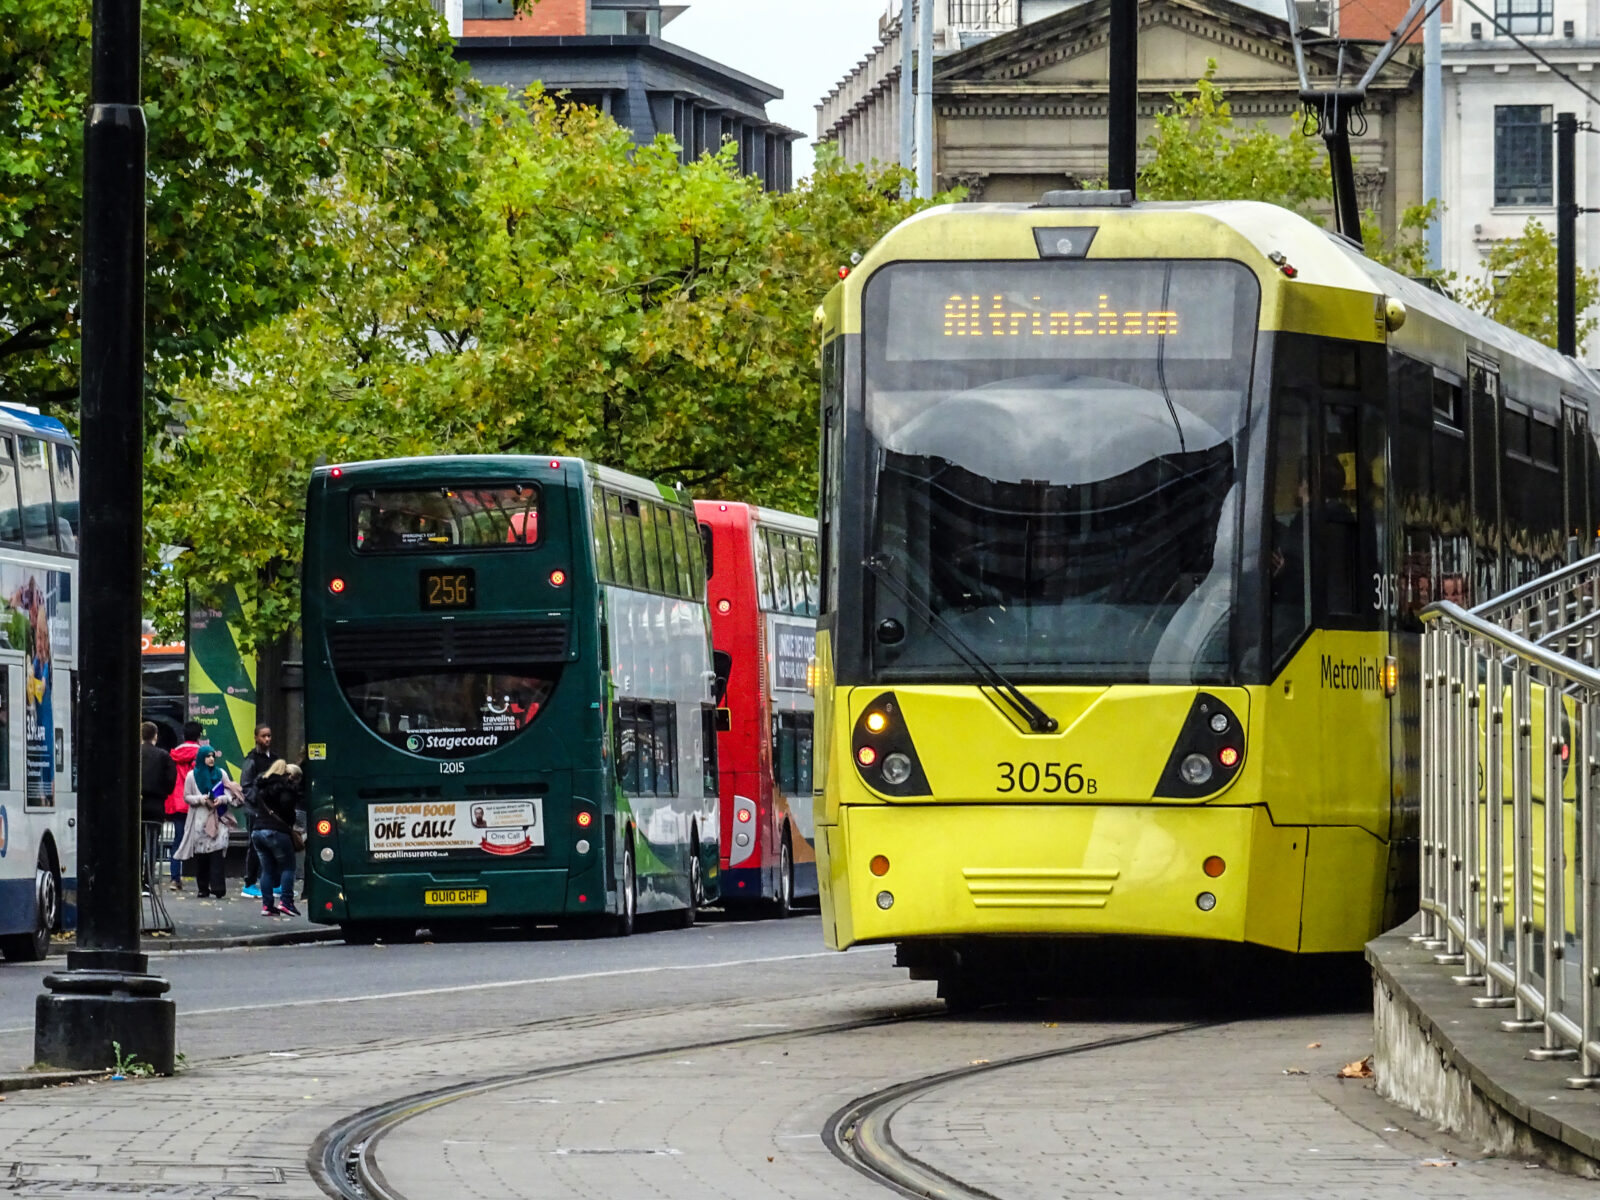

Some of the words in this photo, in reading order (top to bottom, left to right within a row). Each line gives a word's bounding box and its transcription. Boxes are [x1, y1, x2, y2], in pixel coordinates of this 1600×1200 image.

[944, 295, 1177, 335] Altrincham
[429, 575, 467, 604] 256
[1321, 653, 1383, 691] Metrolink
[201, 718, 219, 726] more
[483, 714, 515, 723] traveline
[426, 734, 498, 750] Stagecoach
[440, 762, 465, 774] 12015
[374, 805, 394, 814] BOOM
[395, 804, 422, 815] BOOM
[423, 803, 456, 817] BOOM
[374, 821, 406, 840] ONE
[411, 818, 457, 839] CALL!
[490, 832, 505, 840] One
[507, 832, 520, 840] Call
[458, 890, 480, 902] GHF
